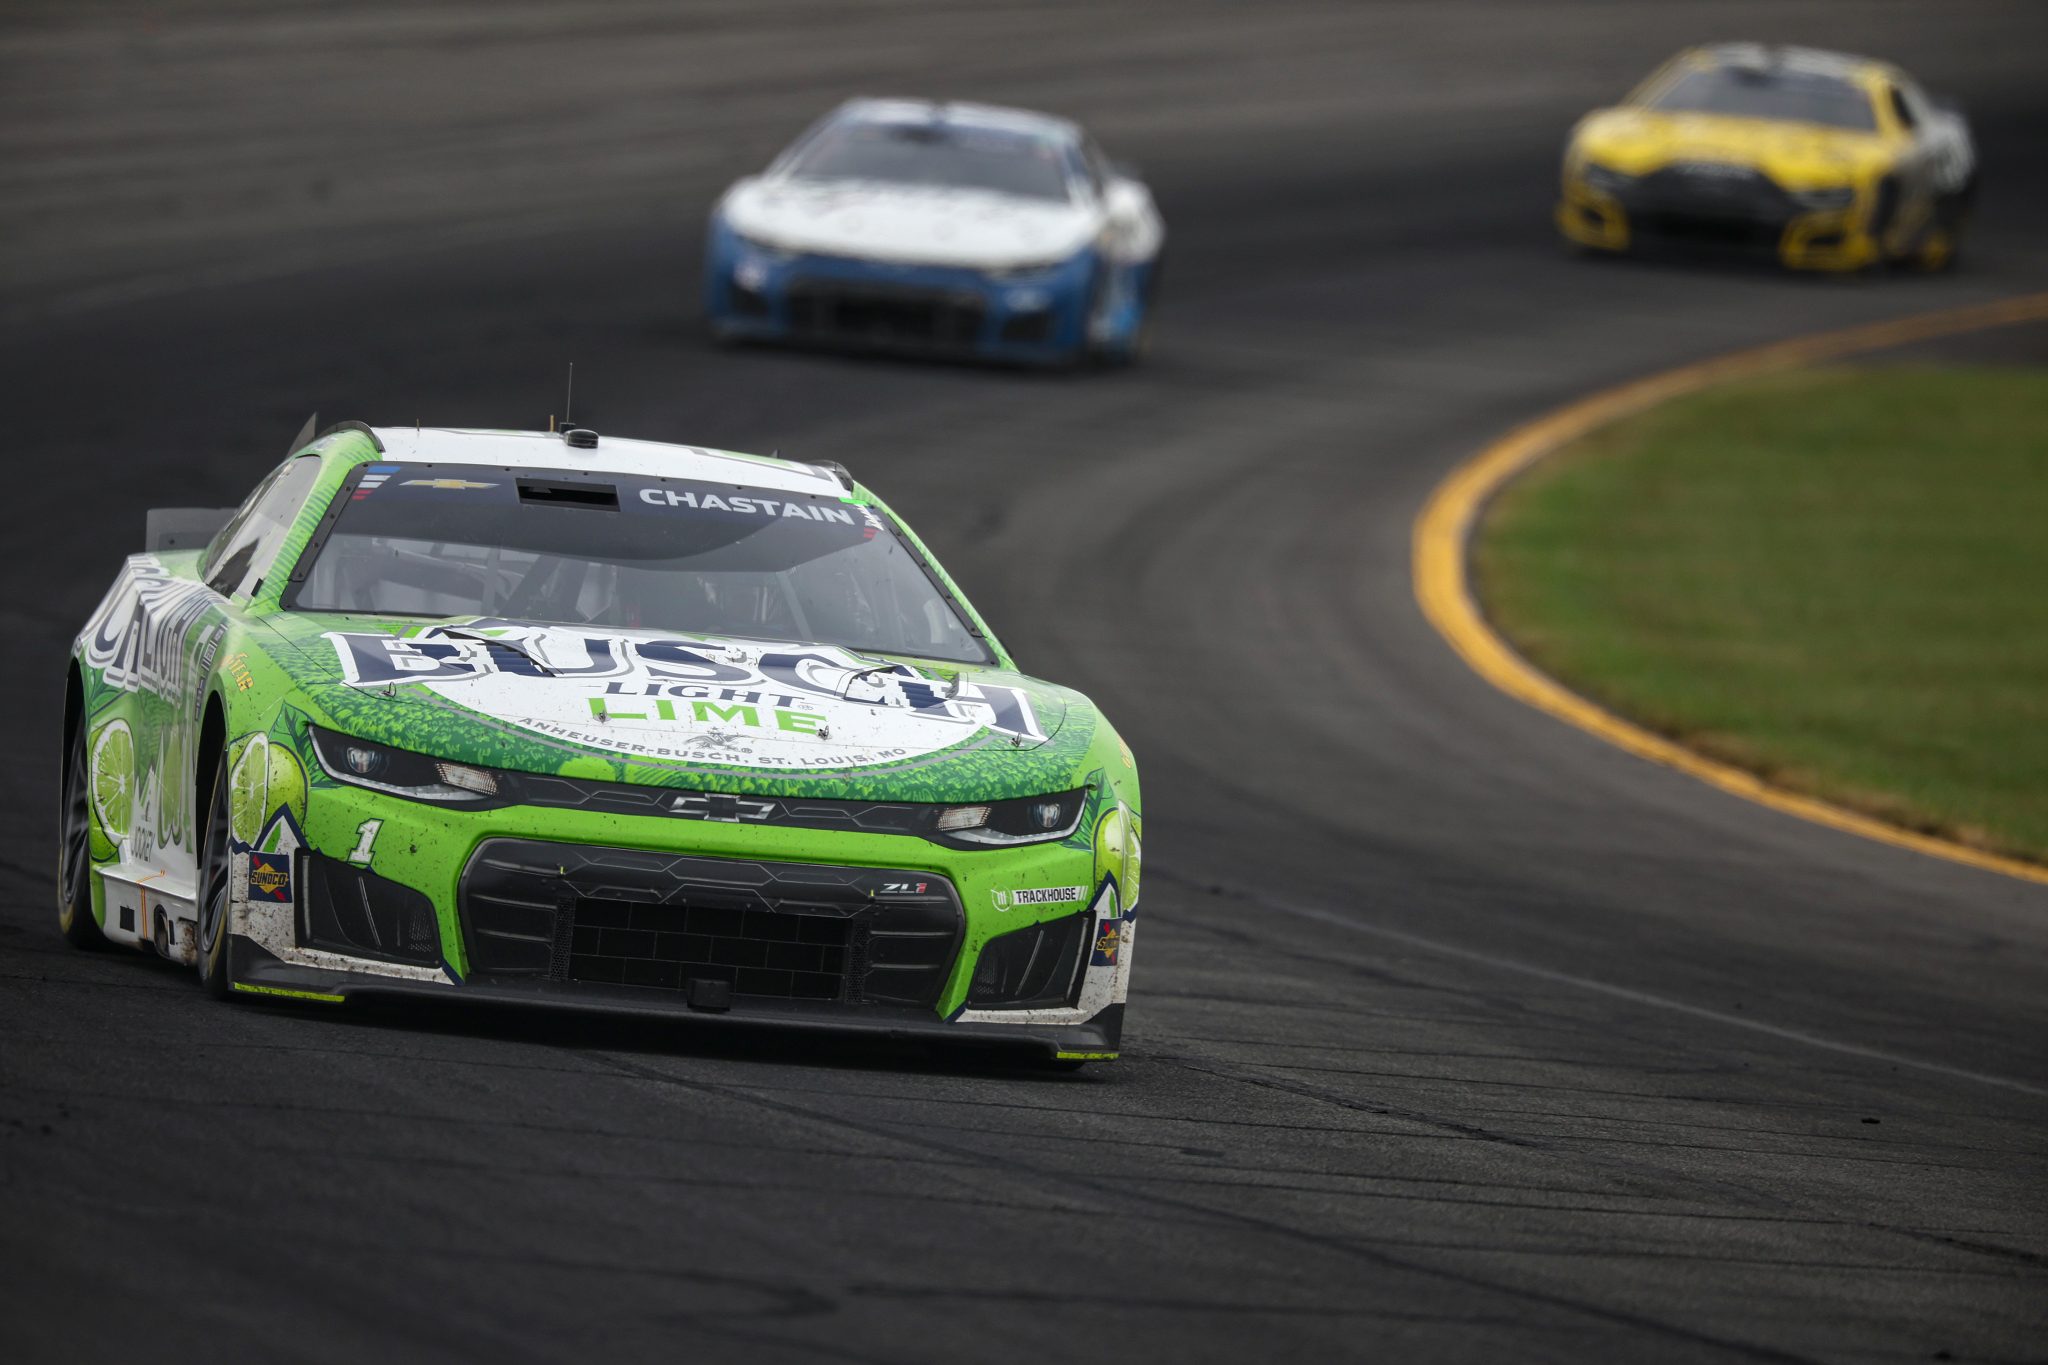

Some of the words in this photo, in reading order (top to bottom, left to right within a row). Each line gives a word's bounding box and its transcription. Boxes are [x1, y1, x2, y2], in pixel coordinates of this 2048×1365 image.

[639, 488, 855, 526] CHASTAIN
[605, 681, 805, 708] LIGHT
[588, 697, 827, 735] LIME
[519, 716, 748, 764] ANHEUSER-BUSCH,
[758, 756, 792, 765] ST.
[881, 748, 907, 761] MO
[348, 817, 384, 865] 1
[251, 870, 289, 886] SUNOCO
[880, 882, 928, 894] ZL1
[1015, 887, 1077, 904] TRACKHOUSE
